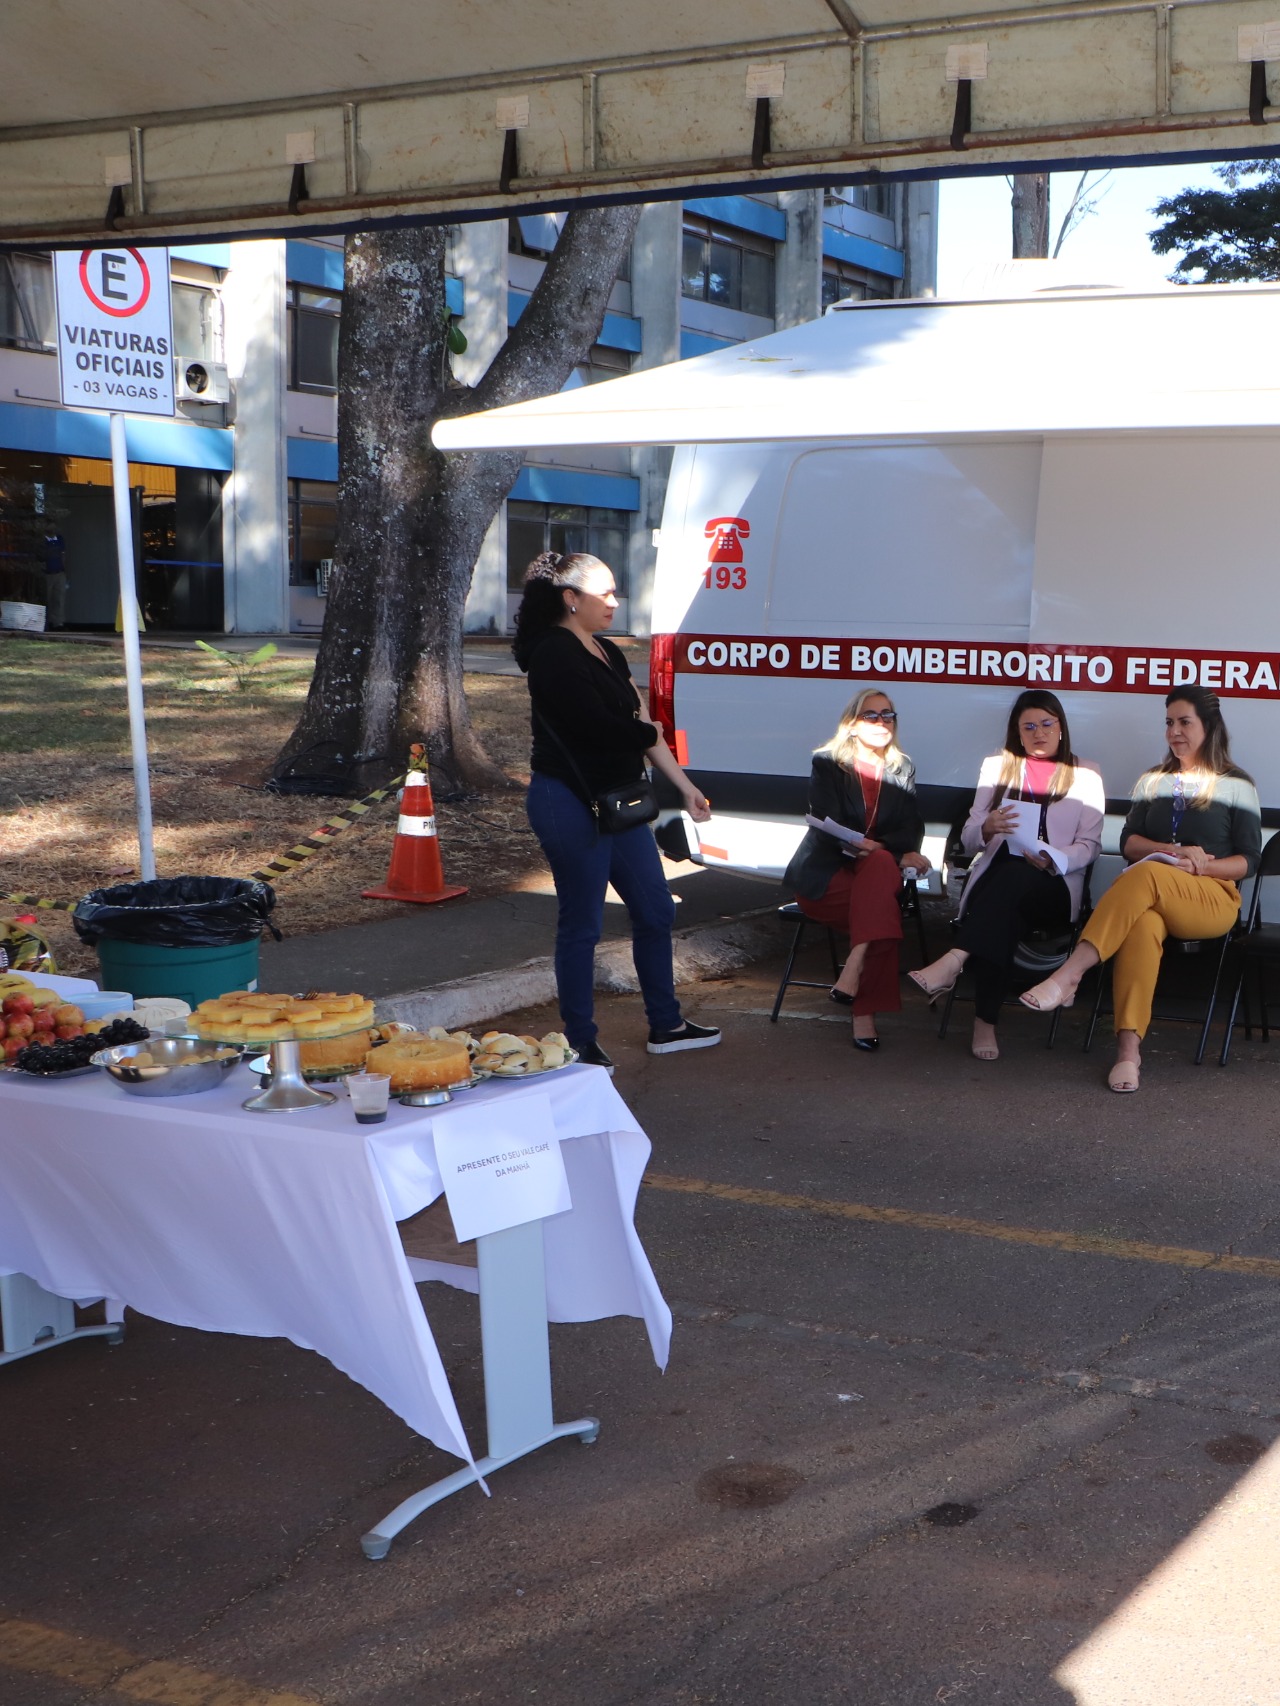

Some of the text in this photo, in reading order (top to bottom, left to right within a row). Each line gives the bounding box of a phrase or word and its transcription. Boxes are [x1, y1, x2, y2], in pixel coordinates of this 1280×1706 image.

[101, 252, 128, 301] E
[64, 324, 168, 356] VIATURAS
[83, 380, 100, 394] 03
[105, 382, 158, 400] VAGAS
[702, 566, 747, 590] 193
[687, 641, 790, 669] CORPO
[801, 645, 840, 671] DE
[457, 1155, 501, 1173] APRESENTE
[508, 1150, 521, 1160] SEU
[521, 1146, 535, 1156] VALE
[535, 1142, 550, 1154] CAFÉ
[495, 1169, 507, 1178] DA
